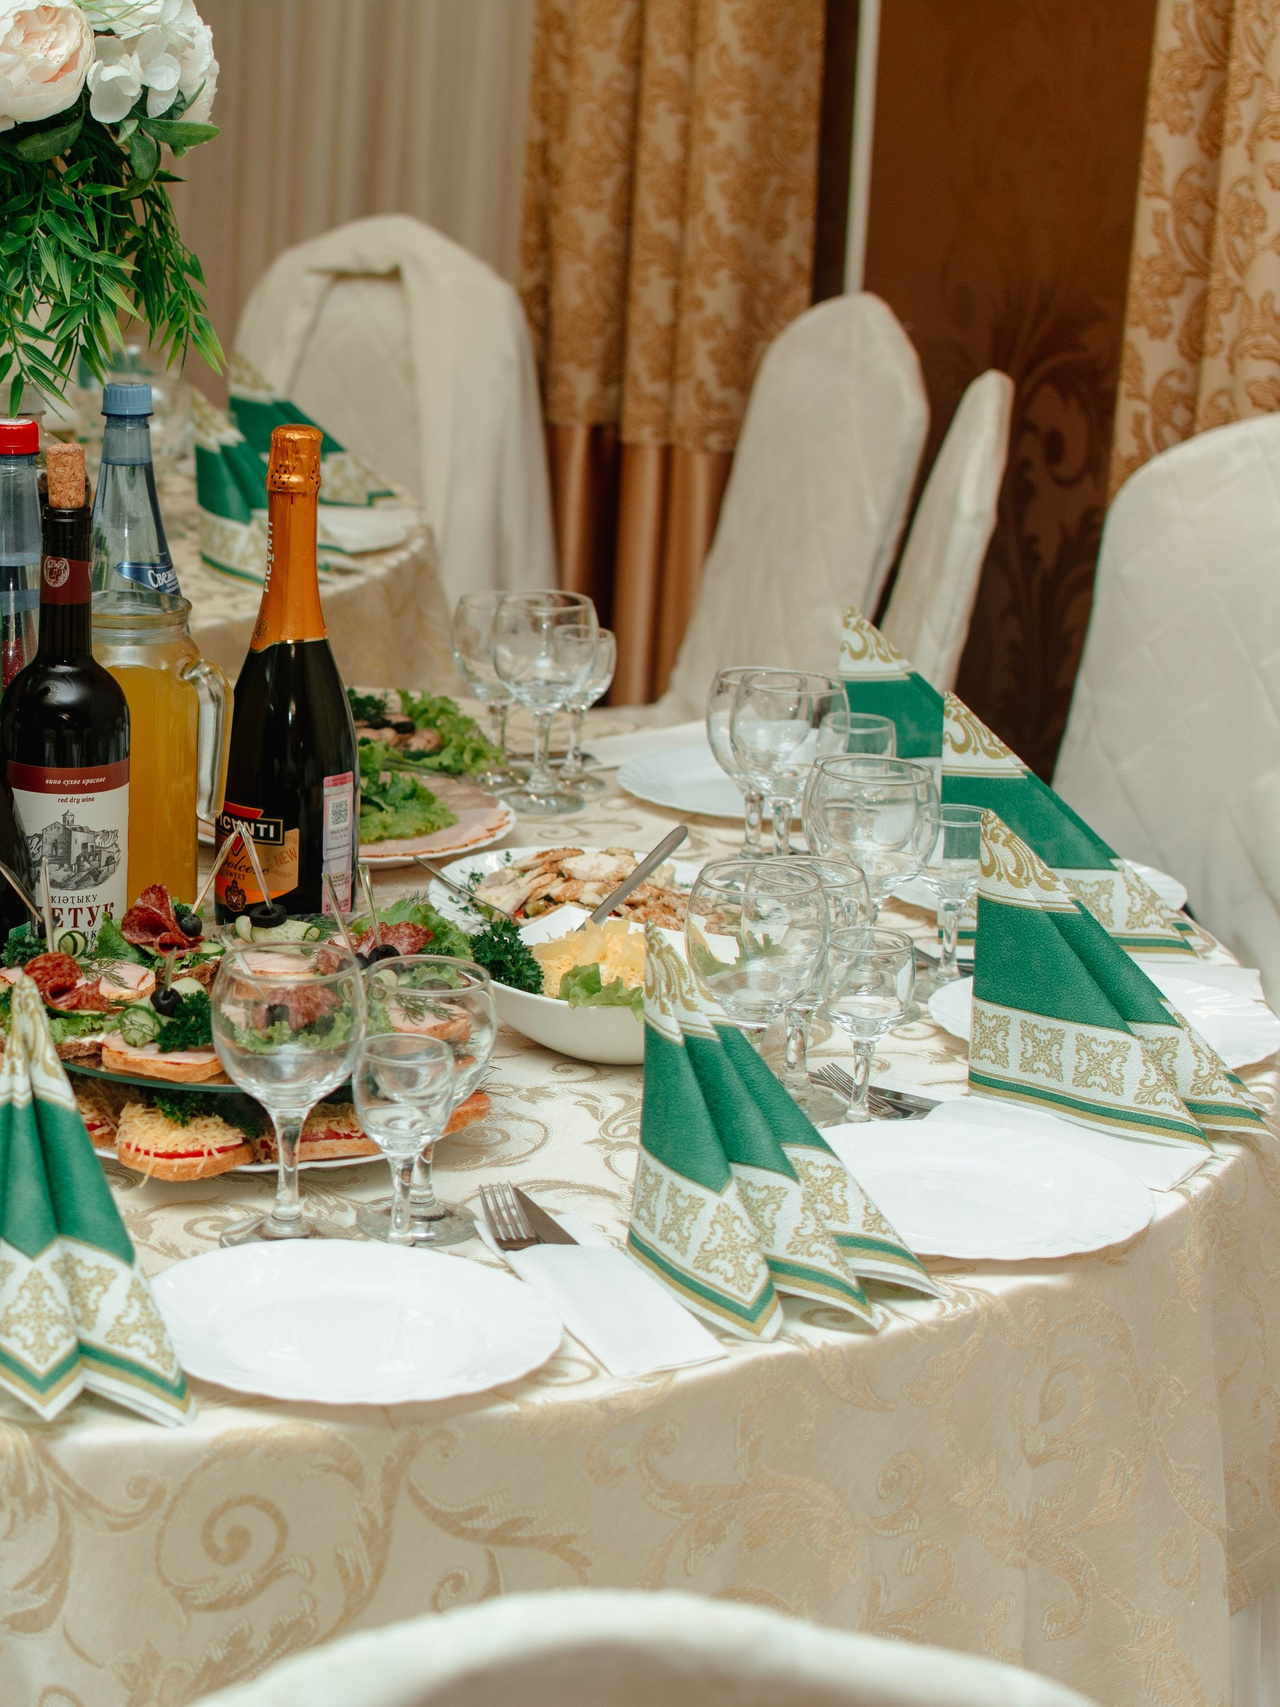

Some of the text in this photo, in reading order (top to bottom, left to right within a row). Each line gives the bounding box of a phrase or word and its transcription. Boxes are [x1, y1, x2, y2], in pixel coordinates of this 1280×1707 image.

[57, 795, 96, 805] red dry wine
[273, 846, 298, 868] NEW
